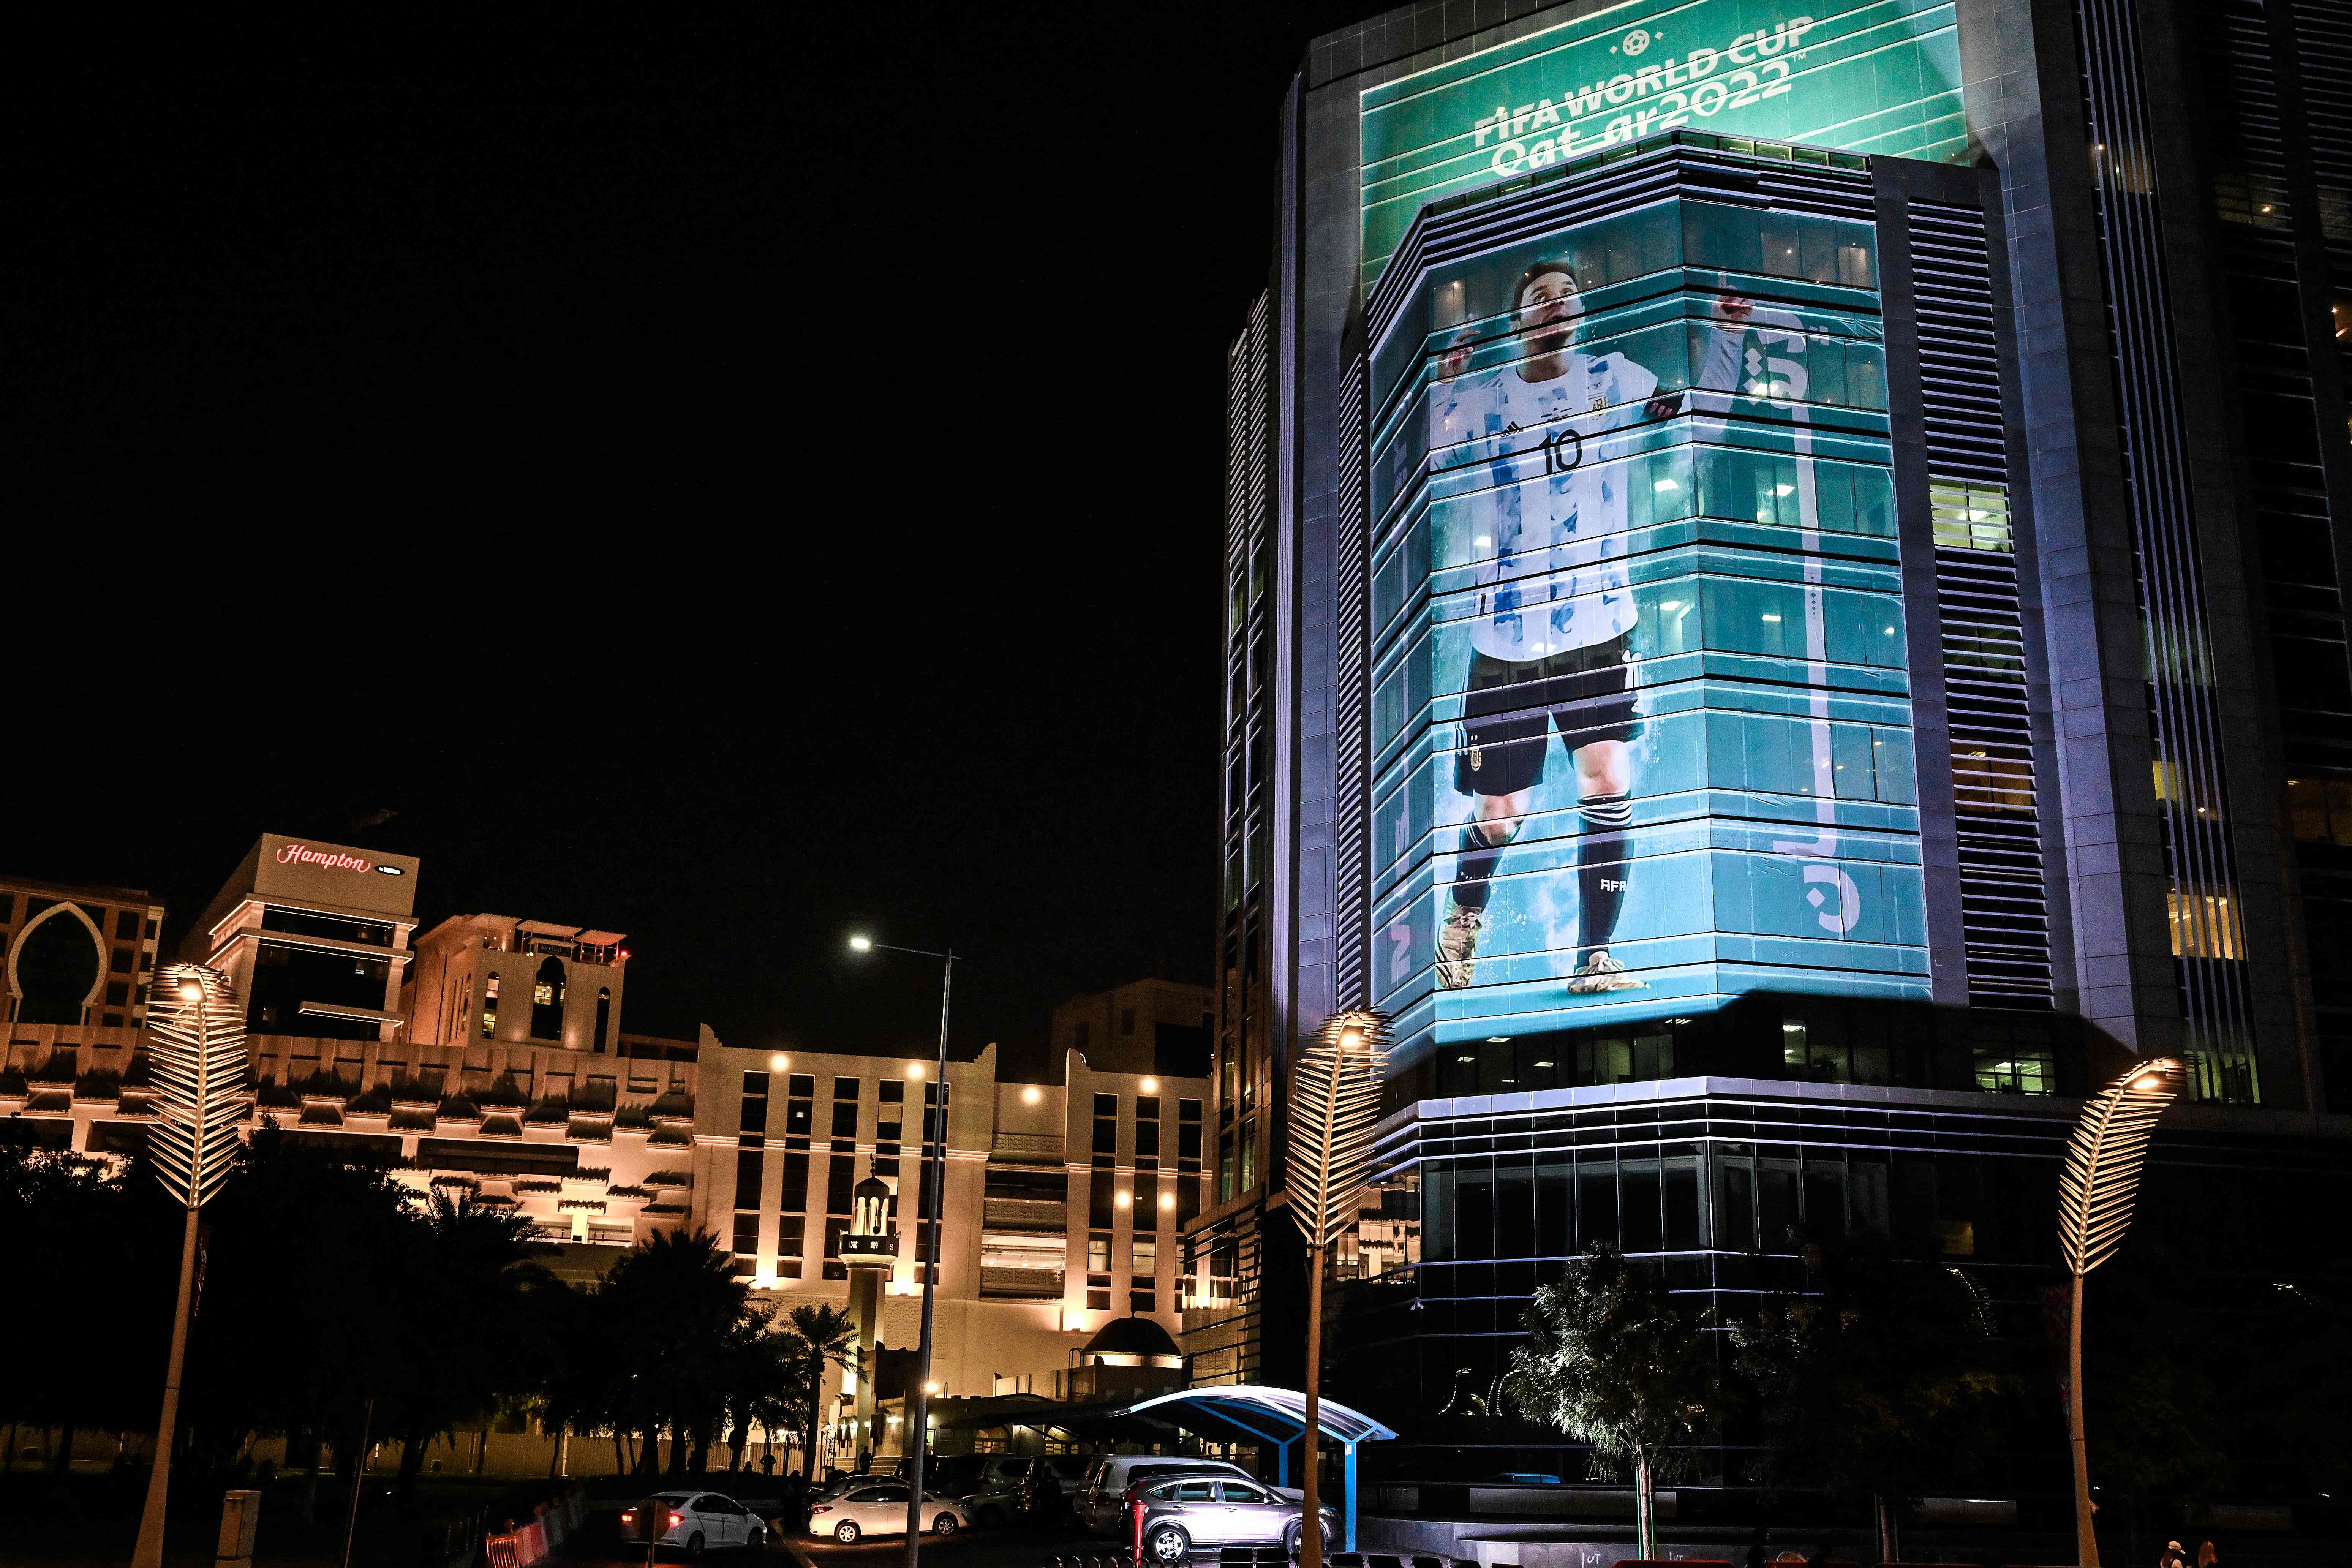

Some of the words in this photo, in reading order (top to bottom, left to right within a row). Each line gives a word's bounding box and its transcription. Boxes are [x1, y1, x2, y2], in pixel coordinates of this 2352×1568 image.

[1475, 100, 1561, 147] FIFA
[1565, 48, 1718, 117] WORLD
[1728, 16, 1813, 64] CUP
[1539, 429, 1582, 475] 10
[277, 844, 371, 873] Hampton
[1600, 879, 1626, 892] AFA
